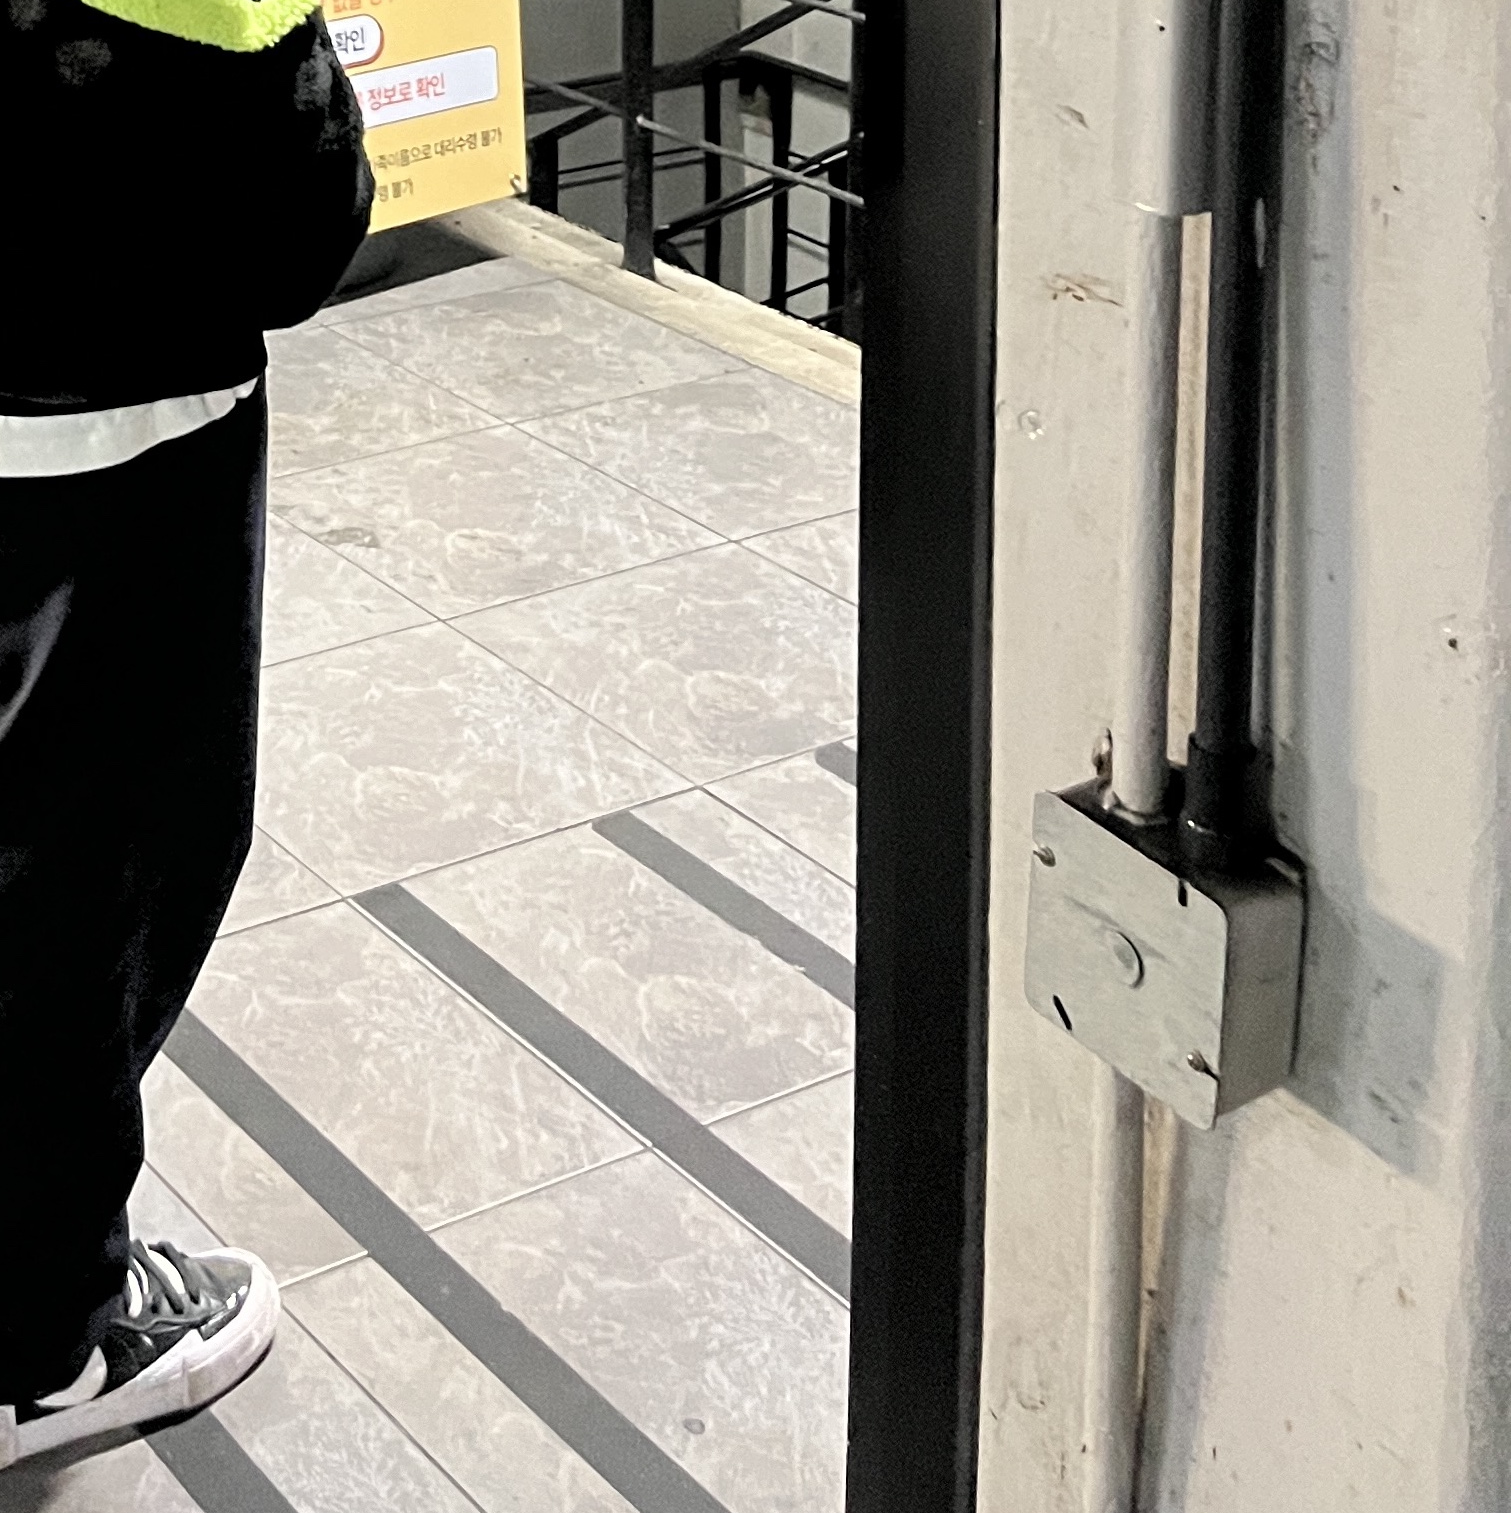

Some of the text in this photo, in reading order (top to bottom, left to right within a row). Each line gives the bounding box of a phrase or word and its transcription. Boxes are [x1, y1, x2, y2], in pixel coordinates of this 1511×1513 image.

[334, 26, 366, 53] 확인
[367, 81, 414, 111] 정보로
[416, 72, 446, 98] 확인
